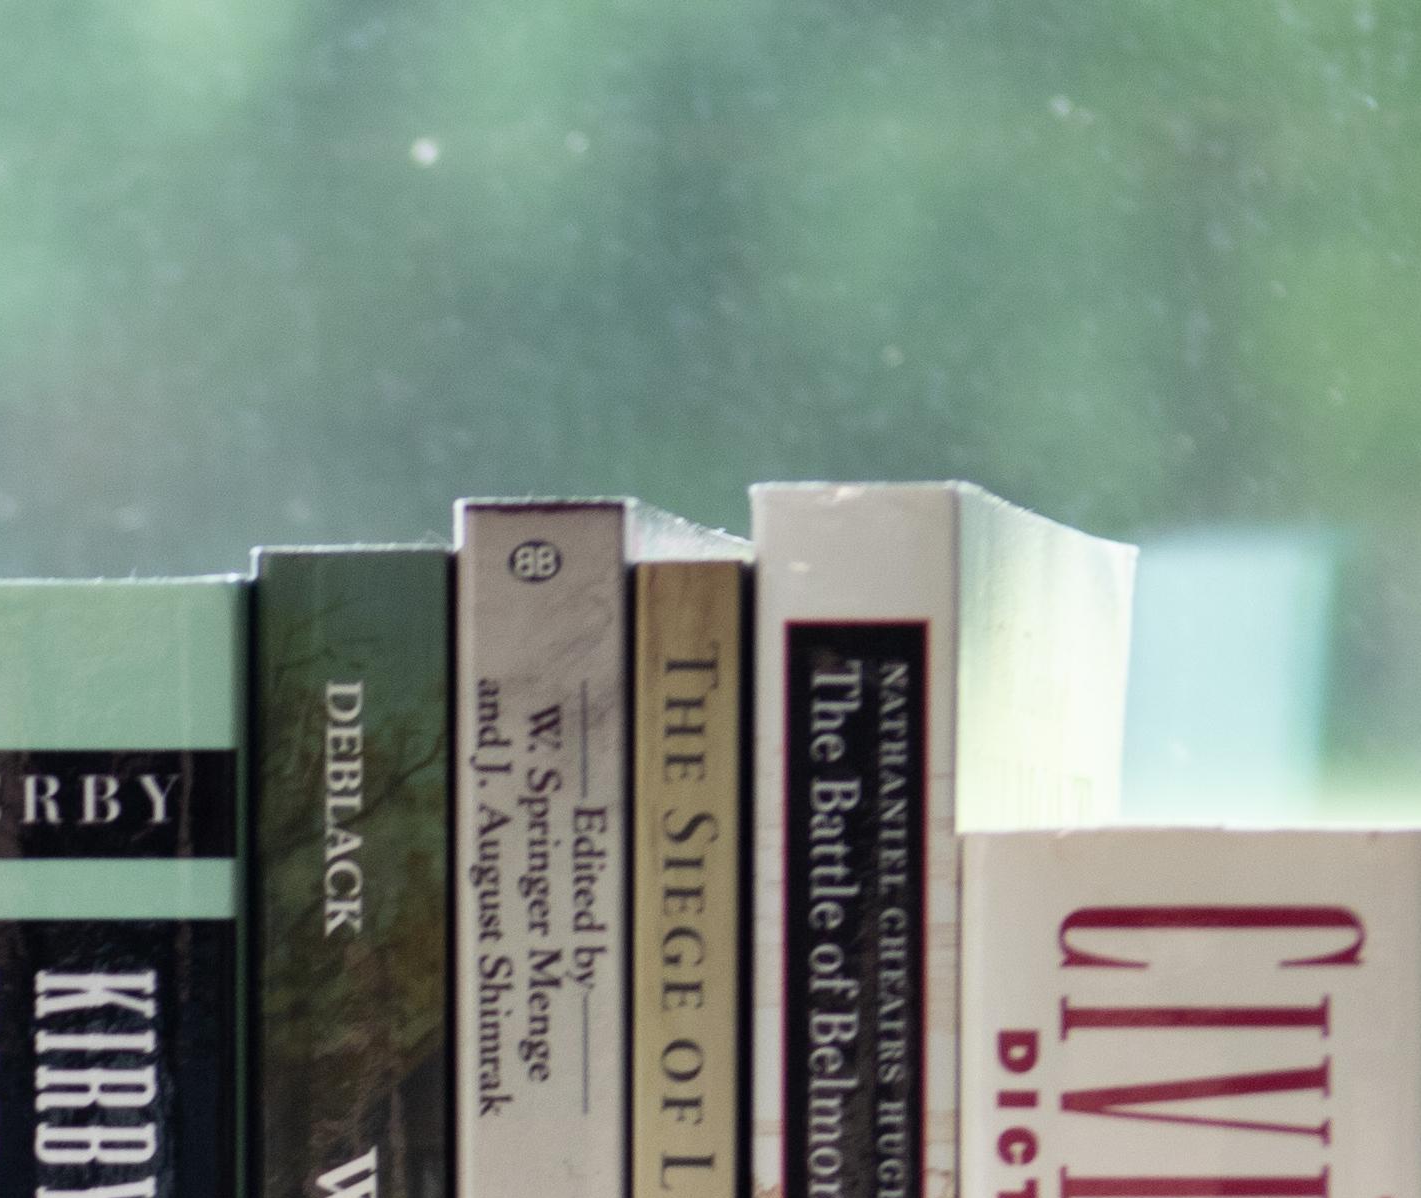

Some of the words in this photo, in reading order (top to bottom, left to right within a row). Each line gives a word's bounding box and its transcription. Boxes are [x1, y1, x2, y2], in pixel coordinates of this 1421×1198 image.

[470, 754, 511, 788] J.
[477, 679, 511, 749] and
[527, 704, 562, 753] W.
[664, 642, 720, 784] THE
[810, 659, 863, 764] The
[878, 661, 908, 896] NATHANIEL
[324, 681, 363, 938] DEBLACK
[469, 803, 512, 942] August
[518, 766, 562, 937] Springer
[572, 805, 607, 934] Edited
[808, 778, 860, 931] Battle
[566, 945, 607, 990] by
[661, 808, 719, 1012] SIEGE
[808, 942, 859, 998] of
[478, 954, 513, 1117] Shimrak
[518, 948, 562, 1084] Menge
[877, 906, 907, 1085] CHEAIRS
[660, 1038, 704, 1126] OF
